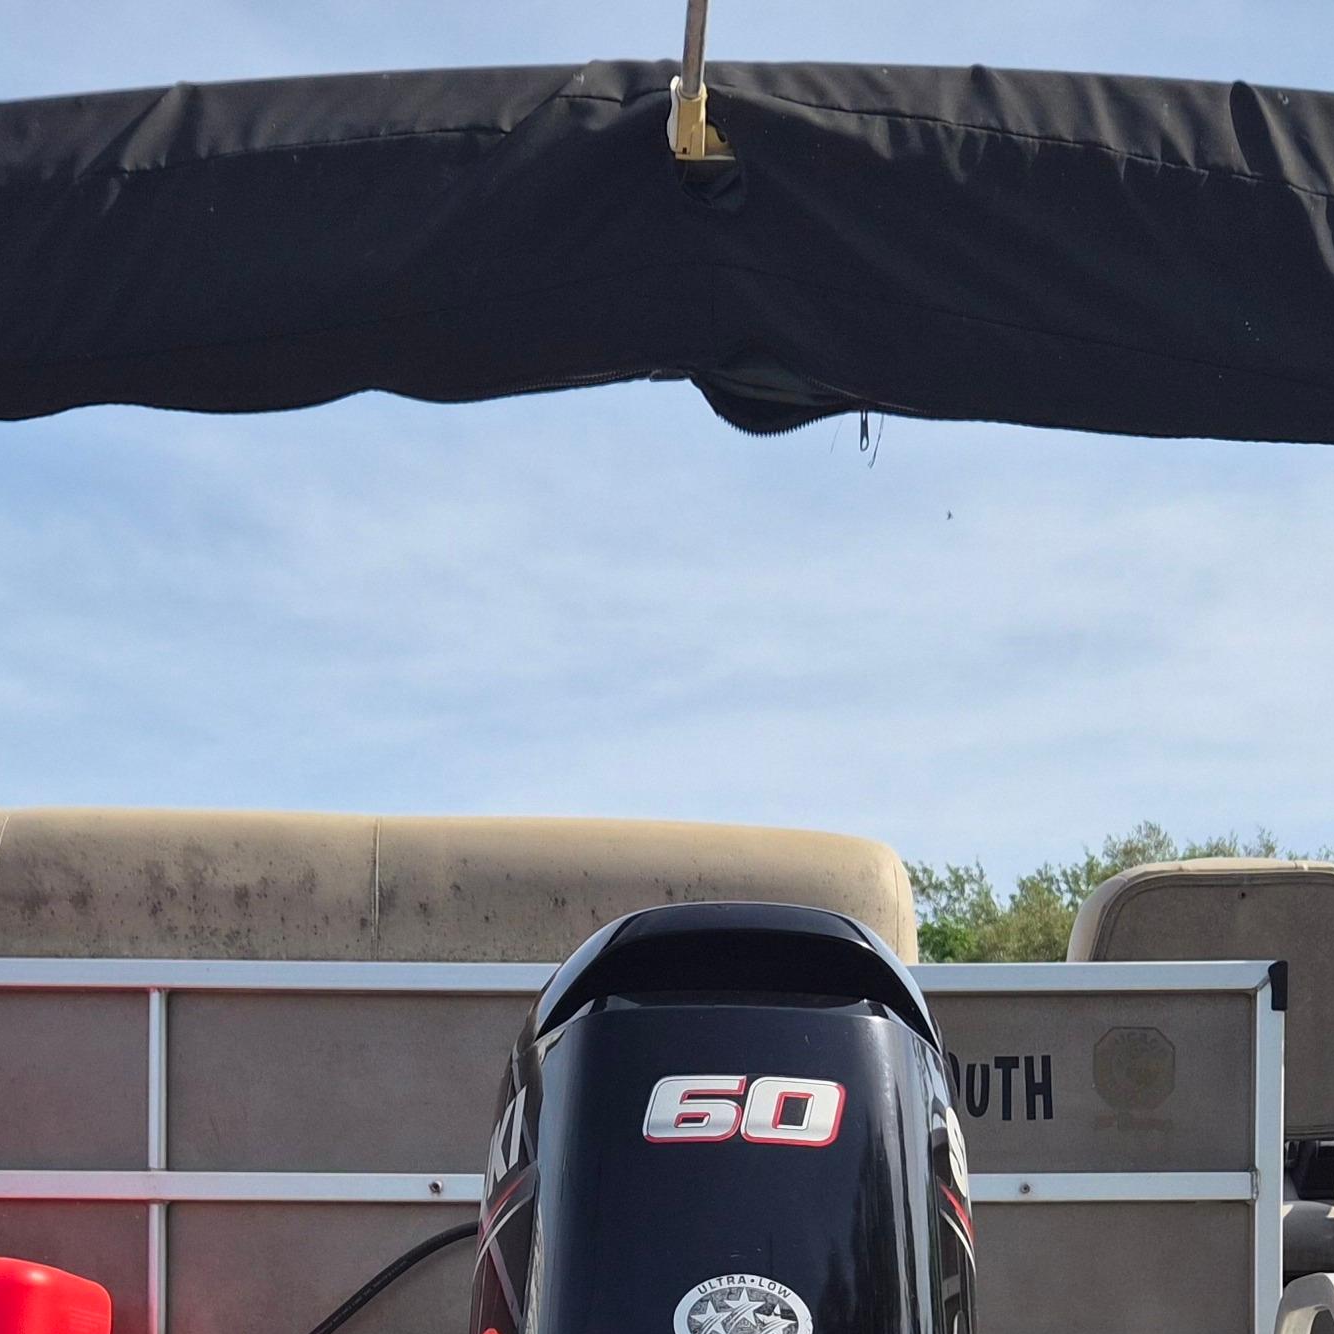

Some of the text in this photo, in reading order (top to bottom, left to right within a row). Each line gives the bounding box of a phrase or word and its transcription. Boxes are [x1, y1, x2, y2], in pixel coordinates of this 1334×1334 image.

[642, 1075, 847, 1147] 60
[698, 1275, 791, 1299] ULTRA LOW
